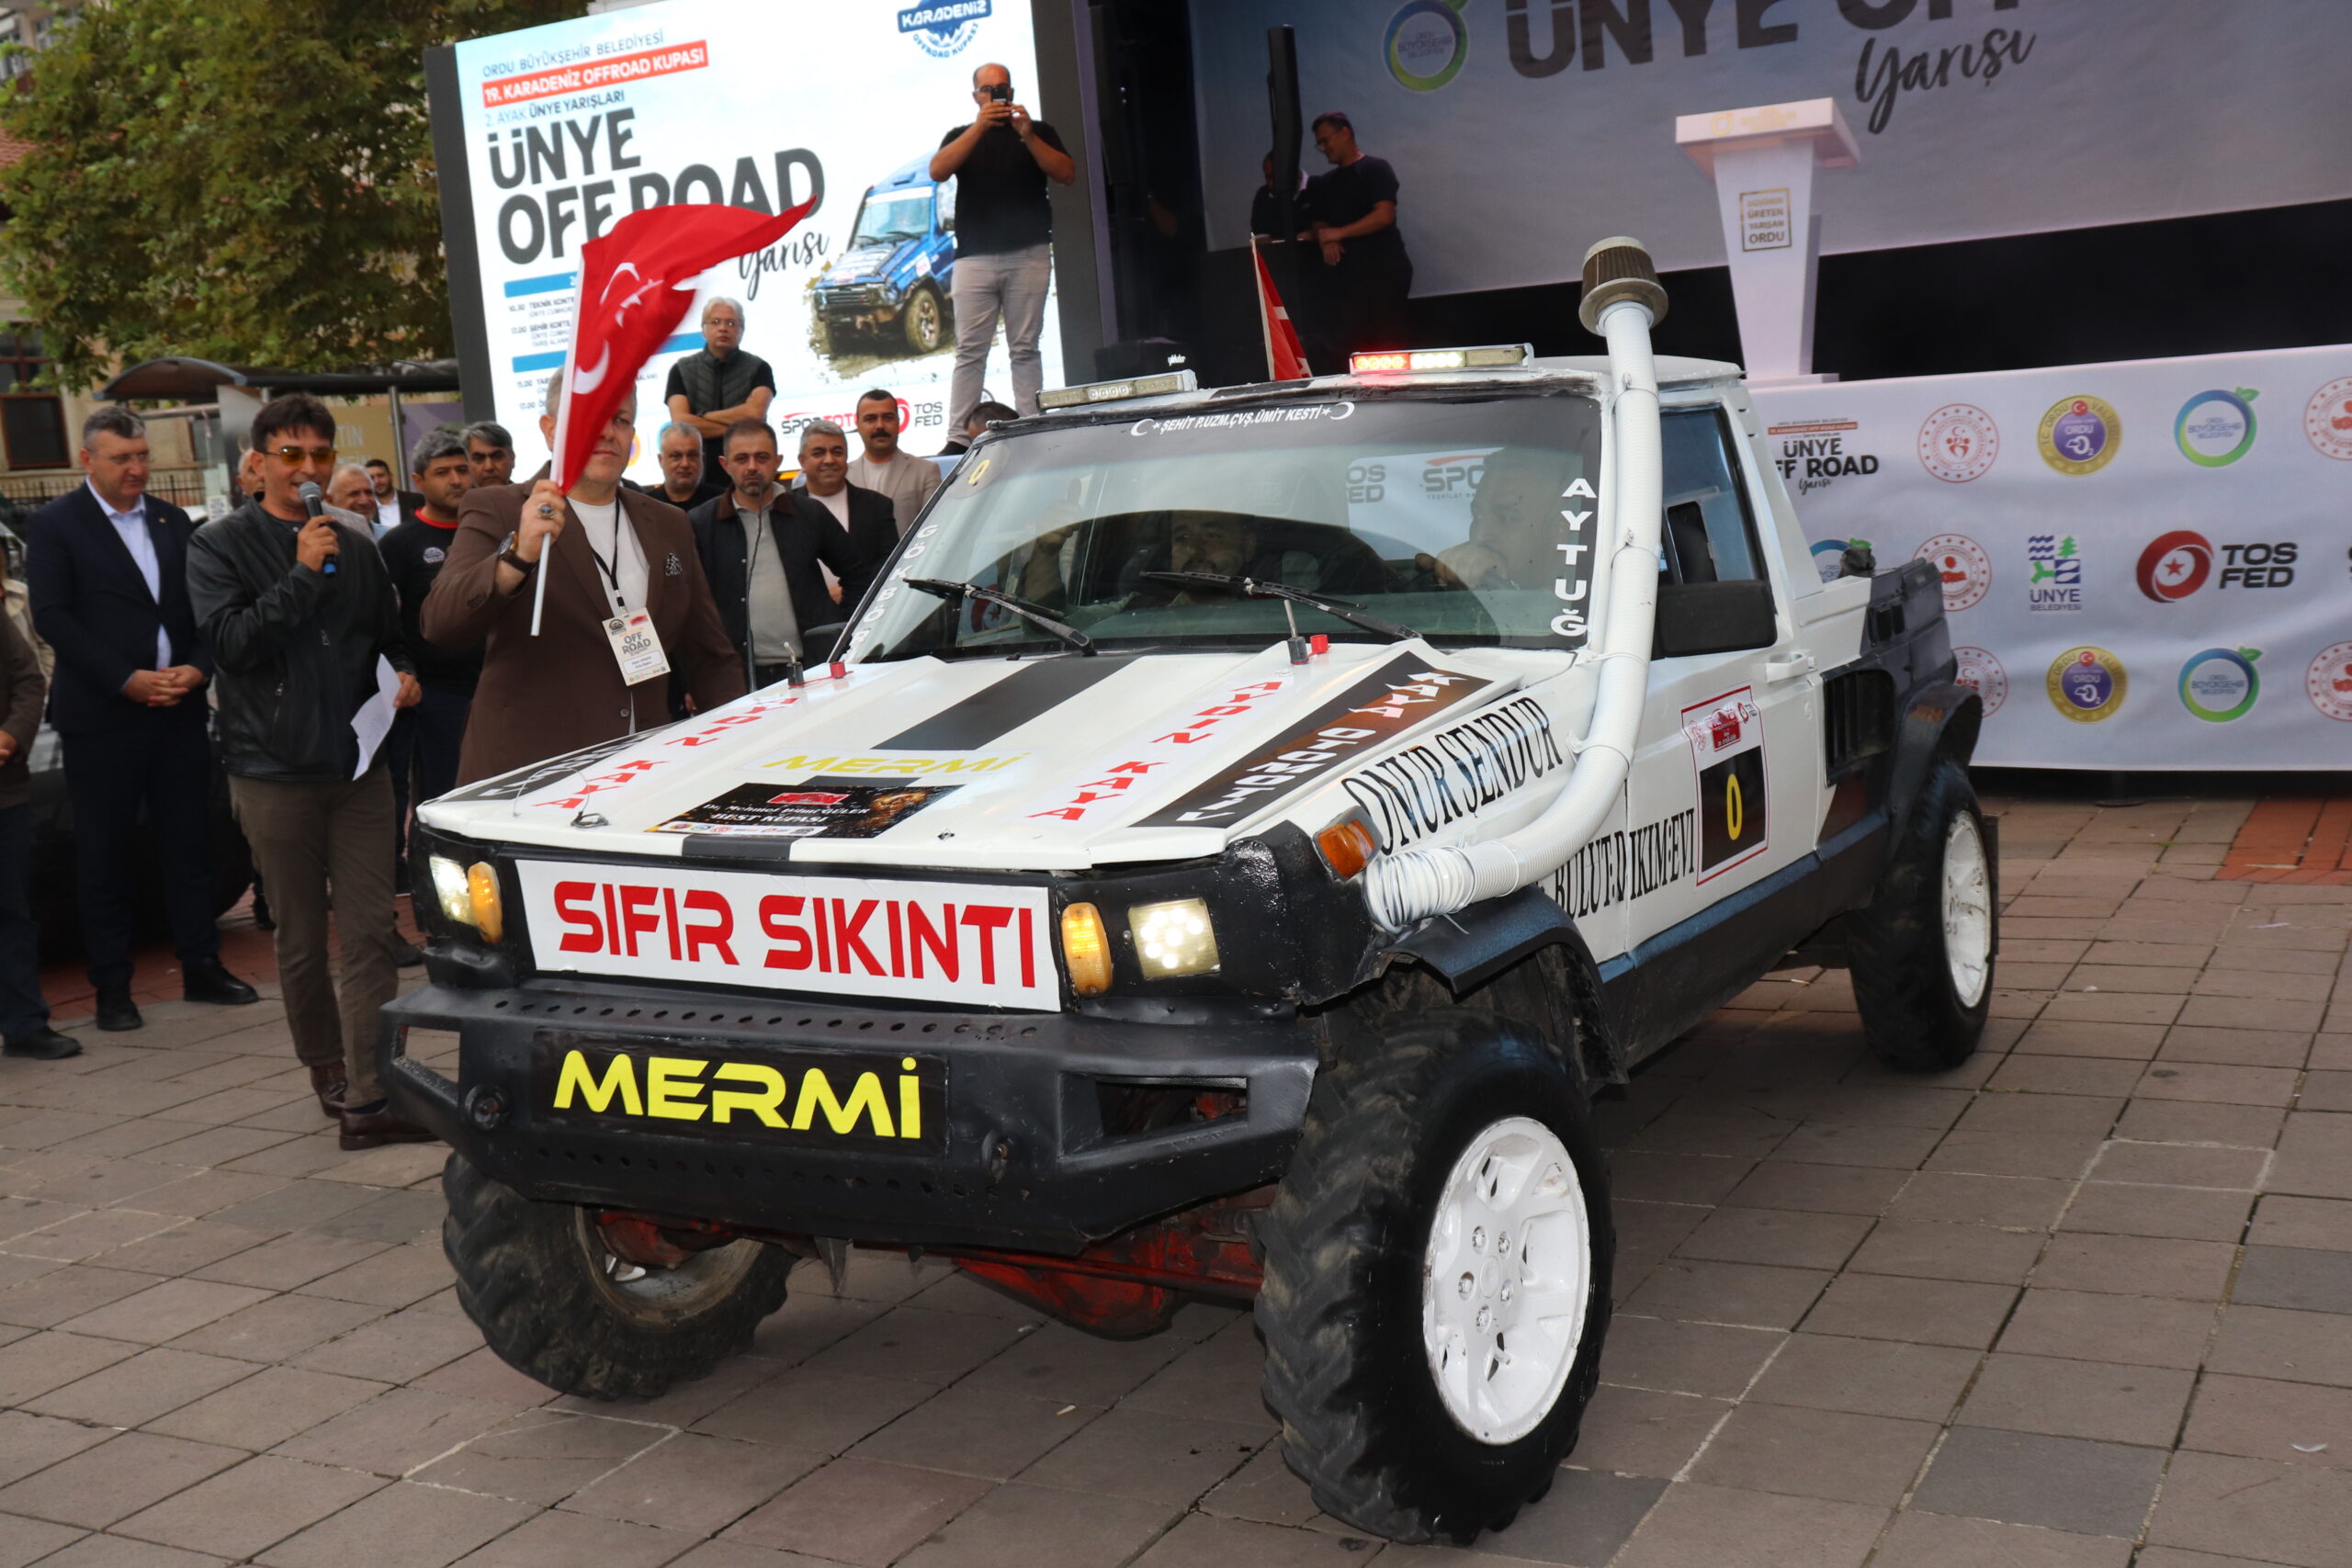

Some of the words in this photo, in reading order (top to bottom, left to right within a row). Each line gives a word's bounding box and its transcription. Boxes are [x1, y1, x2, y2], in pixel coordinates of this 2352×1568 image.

[901, 1, 988, 28] KARADENİZ
[482, 60, 514, 77] ORDU
[519, 43, 591, 70] BÜYÜKŞEHİR
[596, 28, 663, 55] BELEDİYESİ
[484, 86, 503, 103] 19.
[503, 69, 581, 98] KARADENİZ
[582, 58, 650, 85] OFFROAD
[653, 48, 705, 72] KUPASI
[497, 107, 528, 125] AYAK
[529, 99, 560, 118] ÜNYE
[563, 90, 625, 112] YARIŞLARI
[488, 107, 641, 189] ÜNYE
[498, 180, 616, 265] OFF
[1749, 231, 1784, 243] ORDU
[914, 401, 943, 414] TOS
[914, 414, 943, 427] FED
[1160, 414, 1195, 434] ŞEHİT
[1285, 405, 1322, 421] KESTİ
[1783, 437, 1842, 457] ÜNYE
[1346, 465, 1386, 485] OS
[1806, 455, 1879, 478] ROAD
[1347, 484, 1385, 503] ED
[1550, 478, 1598, 637] AYTUĞ
[2222, 542, 2298, 566] TOS
[2218, 566, 2294, 589] FED
[622, 638, 651, 654] ROAD
[624, 632, 643, 644] OFF
[1348, 671, 1470, 718] KAYA
[1149, 682, 1283, 744] AYDIN
[762, 751, 1033, 774] MERMİ
[533, 760, 669, 808] KAYA
[1024, 761, 1170, 820] KAYA
[1341, 745, 1463, 856] ONUR
[1727, 773, 1743, 840] 0
[553, 880, 741, 965] SIFIR
[757, 893, 1036, 989] SIKINTI
[553, 1050, 922, 1139] MERMİ
